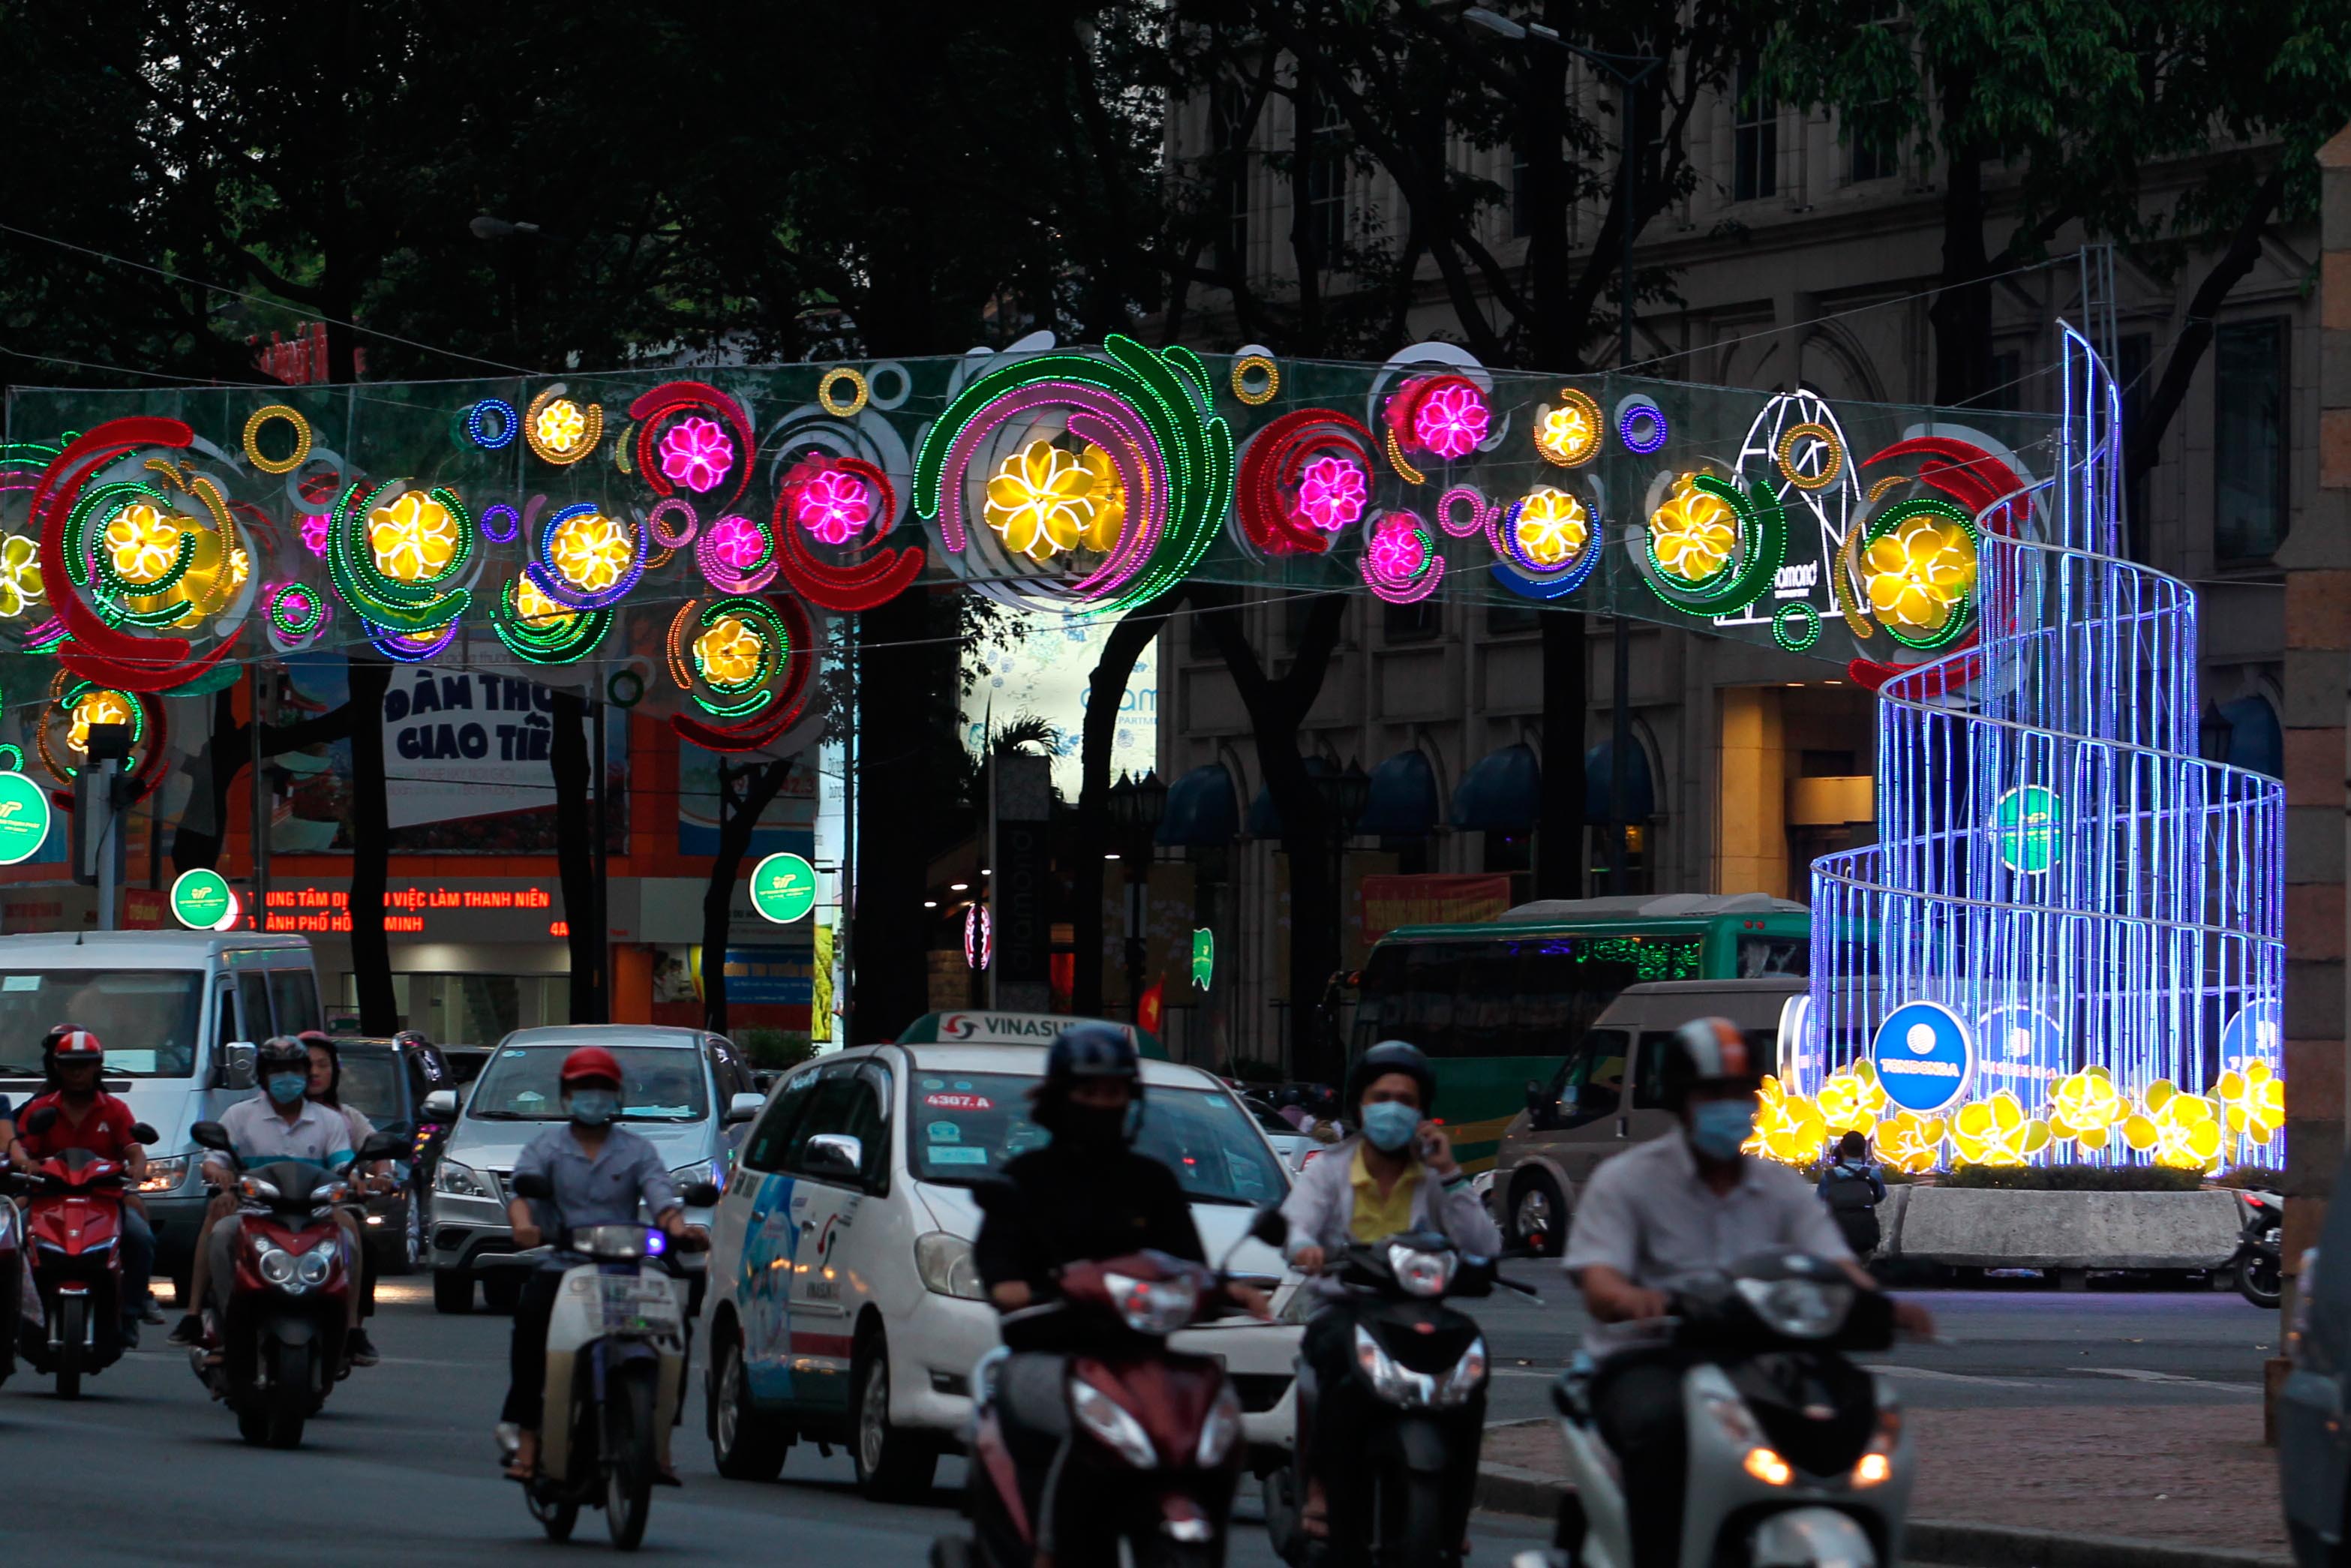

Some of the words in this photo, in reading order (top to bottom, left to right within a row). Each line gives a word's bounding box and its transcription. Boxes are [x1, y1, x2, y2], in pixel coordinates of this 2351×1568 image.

[1773, 560, 1818, 588] amond
[384, 669, 473, 722] ĐÀM
[478, 674, 591, 718] THO
[397, 722, 488, 759] GIAO
[496, 711, 551, 761] TIẾ
[247, 891, 296, 907] TUNG
[298, 888, 329, 907] TÂM
[332, 892, 350, 911] DỊ
[392, 888, 426, 912] VIỆC
[429, 888, 461, 907] LÀM
[463, 892, 513, 908] THANH
[514, 888, 550, 908] NIÊN
[298, 910, 331, 932] PHỐ
[383, 917, 424, 932] MINH
[984, 1016, 1076, 1038] VINASU
